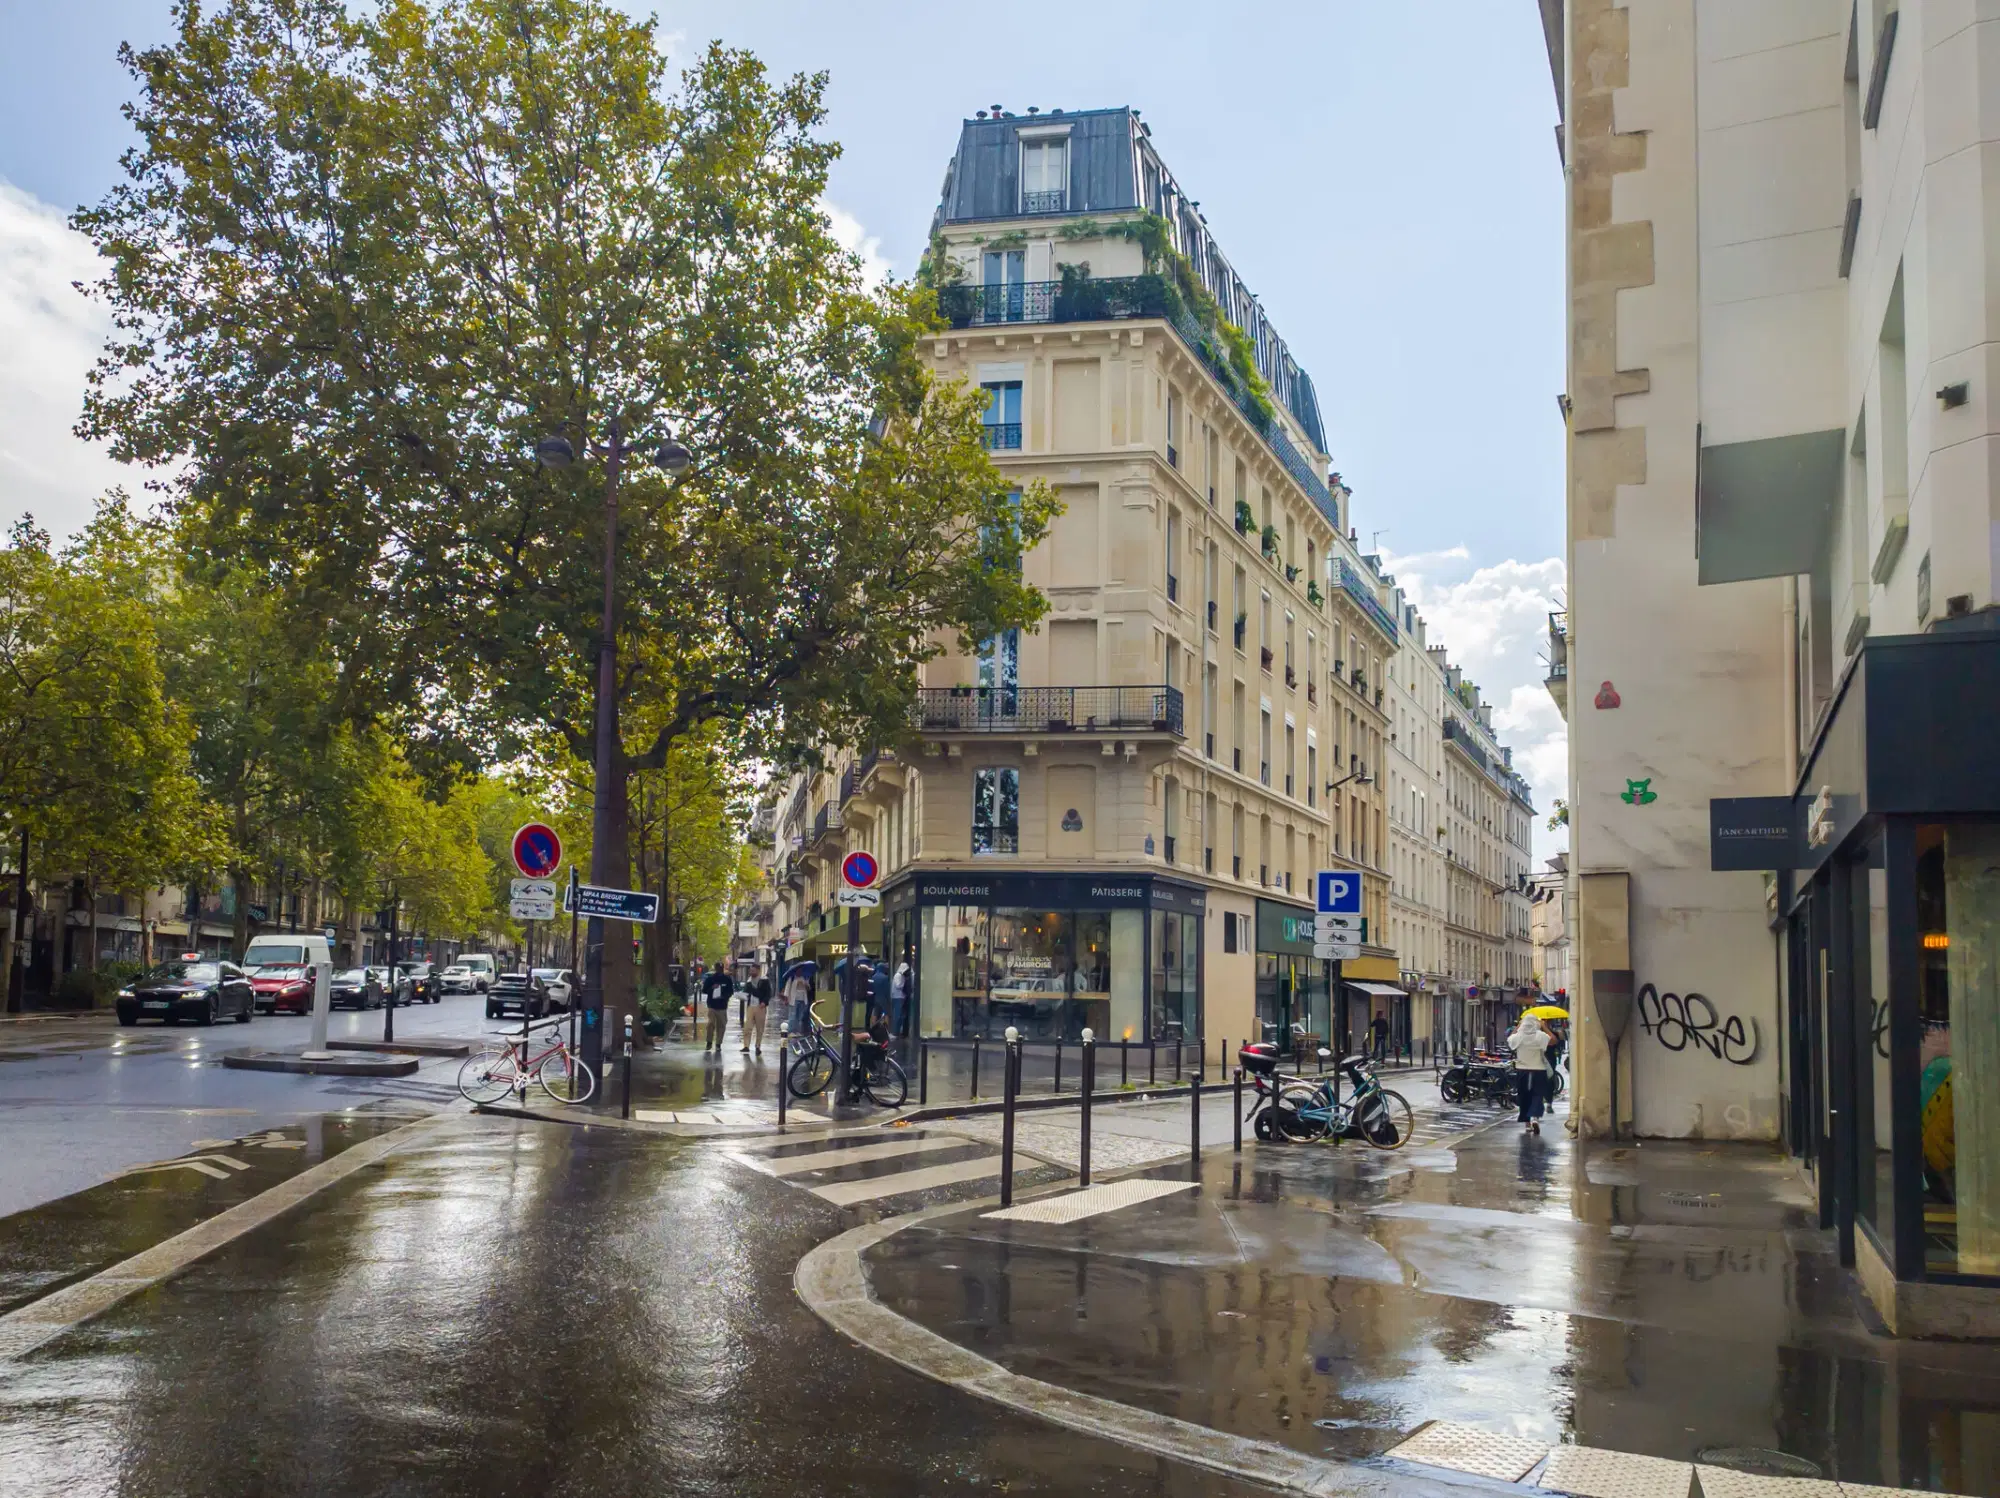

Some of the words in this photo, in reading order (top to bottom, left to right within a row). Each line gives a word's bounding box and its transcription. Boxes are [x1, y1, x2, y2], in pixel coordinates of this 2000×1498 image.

[923, 886, 990, 896] BOULANGERIE
[1091, 887, 1143, 898] PATISSERIE
[1328, 879, 1349, 906] P
[830, 943, 868, 954] PIZA
